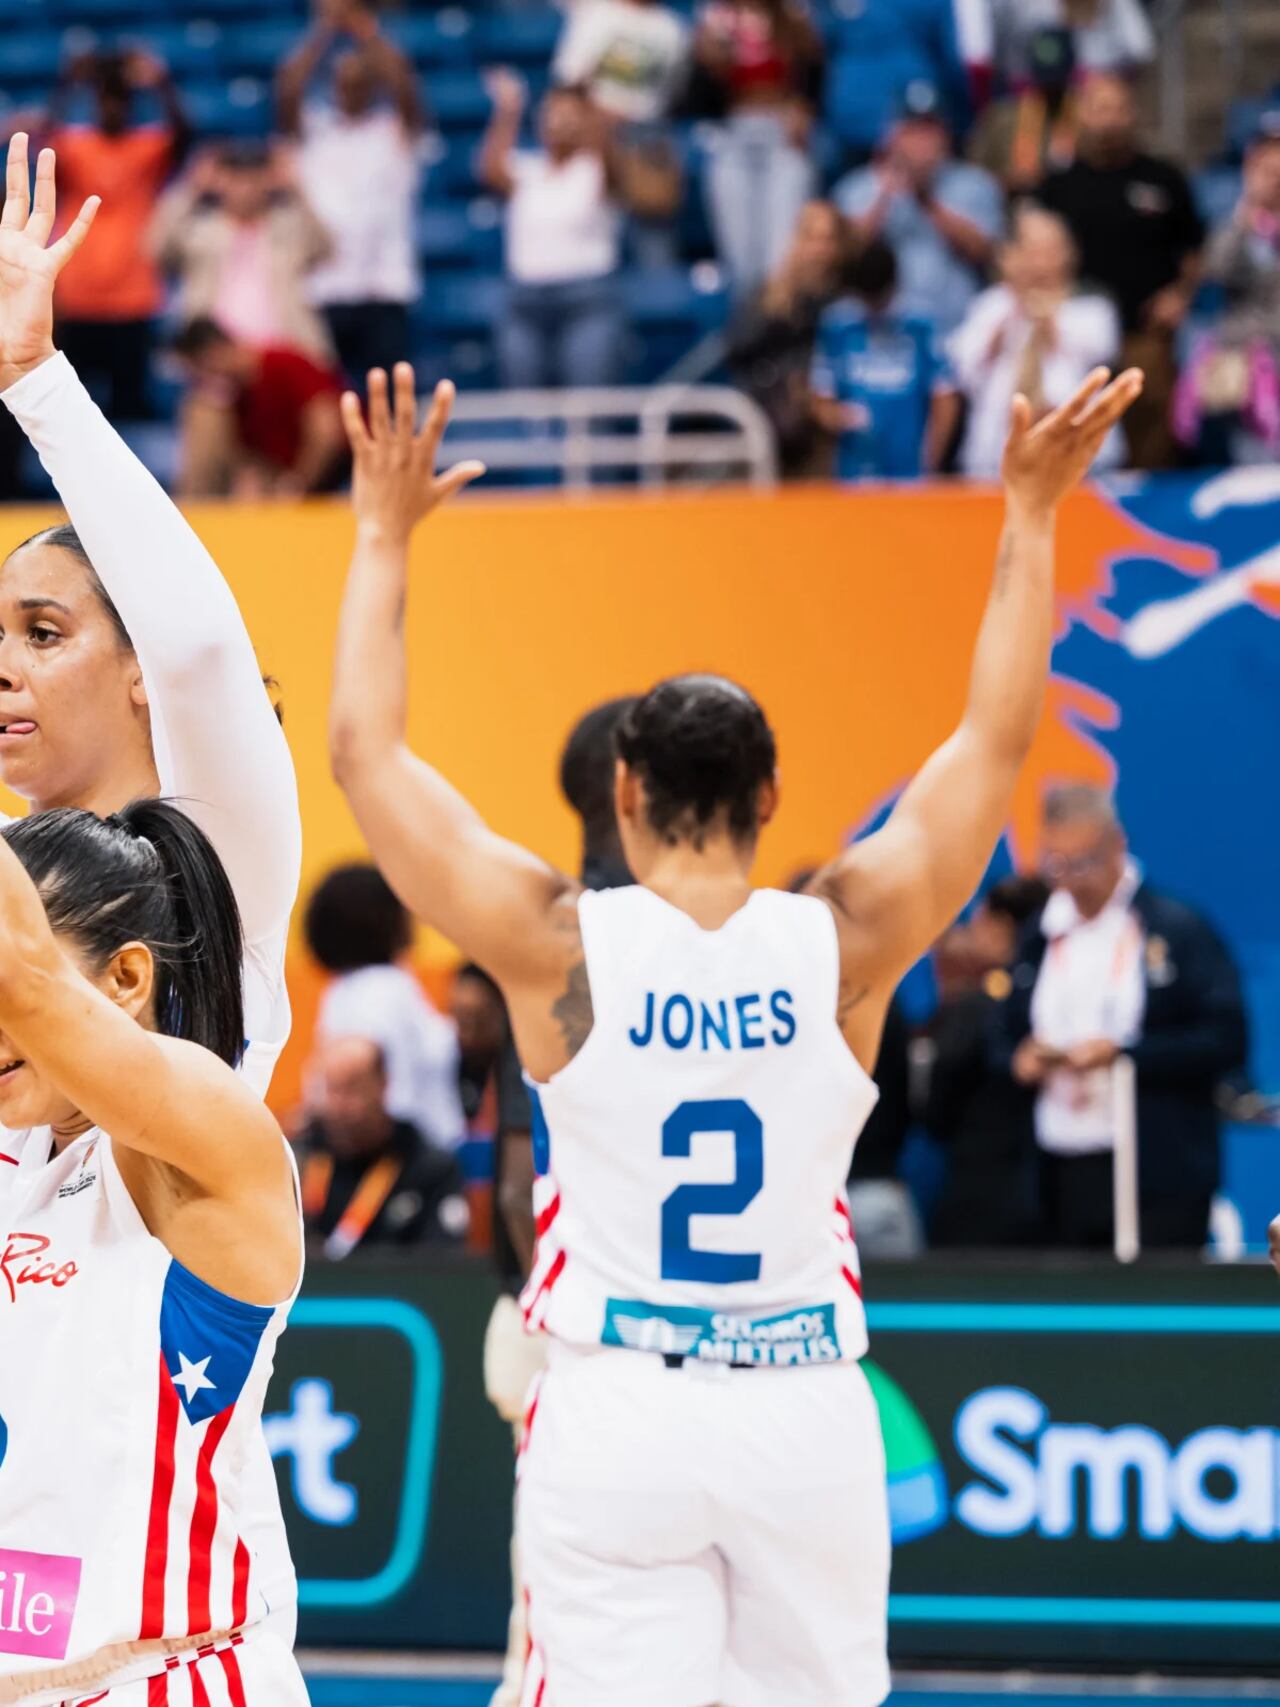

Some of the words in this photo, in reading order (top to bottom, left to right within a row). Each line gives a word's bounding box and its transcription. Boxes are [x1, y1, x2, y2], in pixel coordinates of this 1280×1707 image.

[628, 989, 797, 1051] JONES
[660, 1098, 764, 1285] 2
[1, 1232, 78, 1303] Rico
